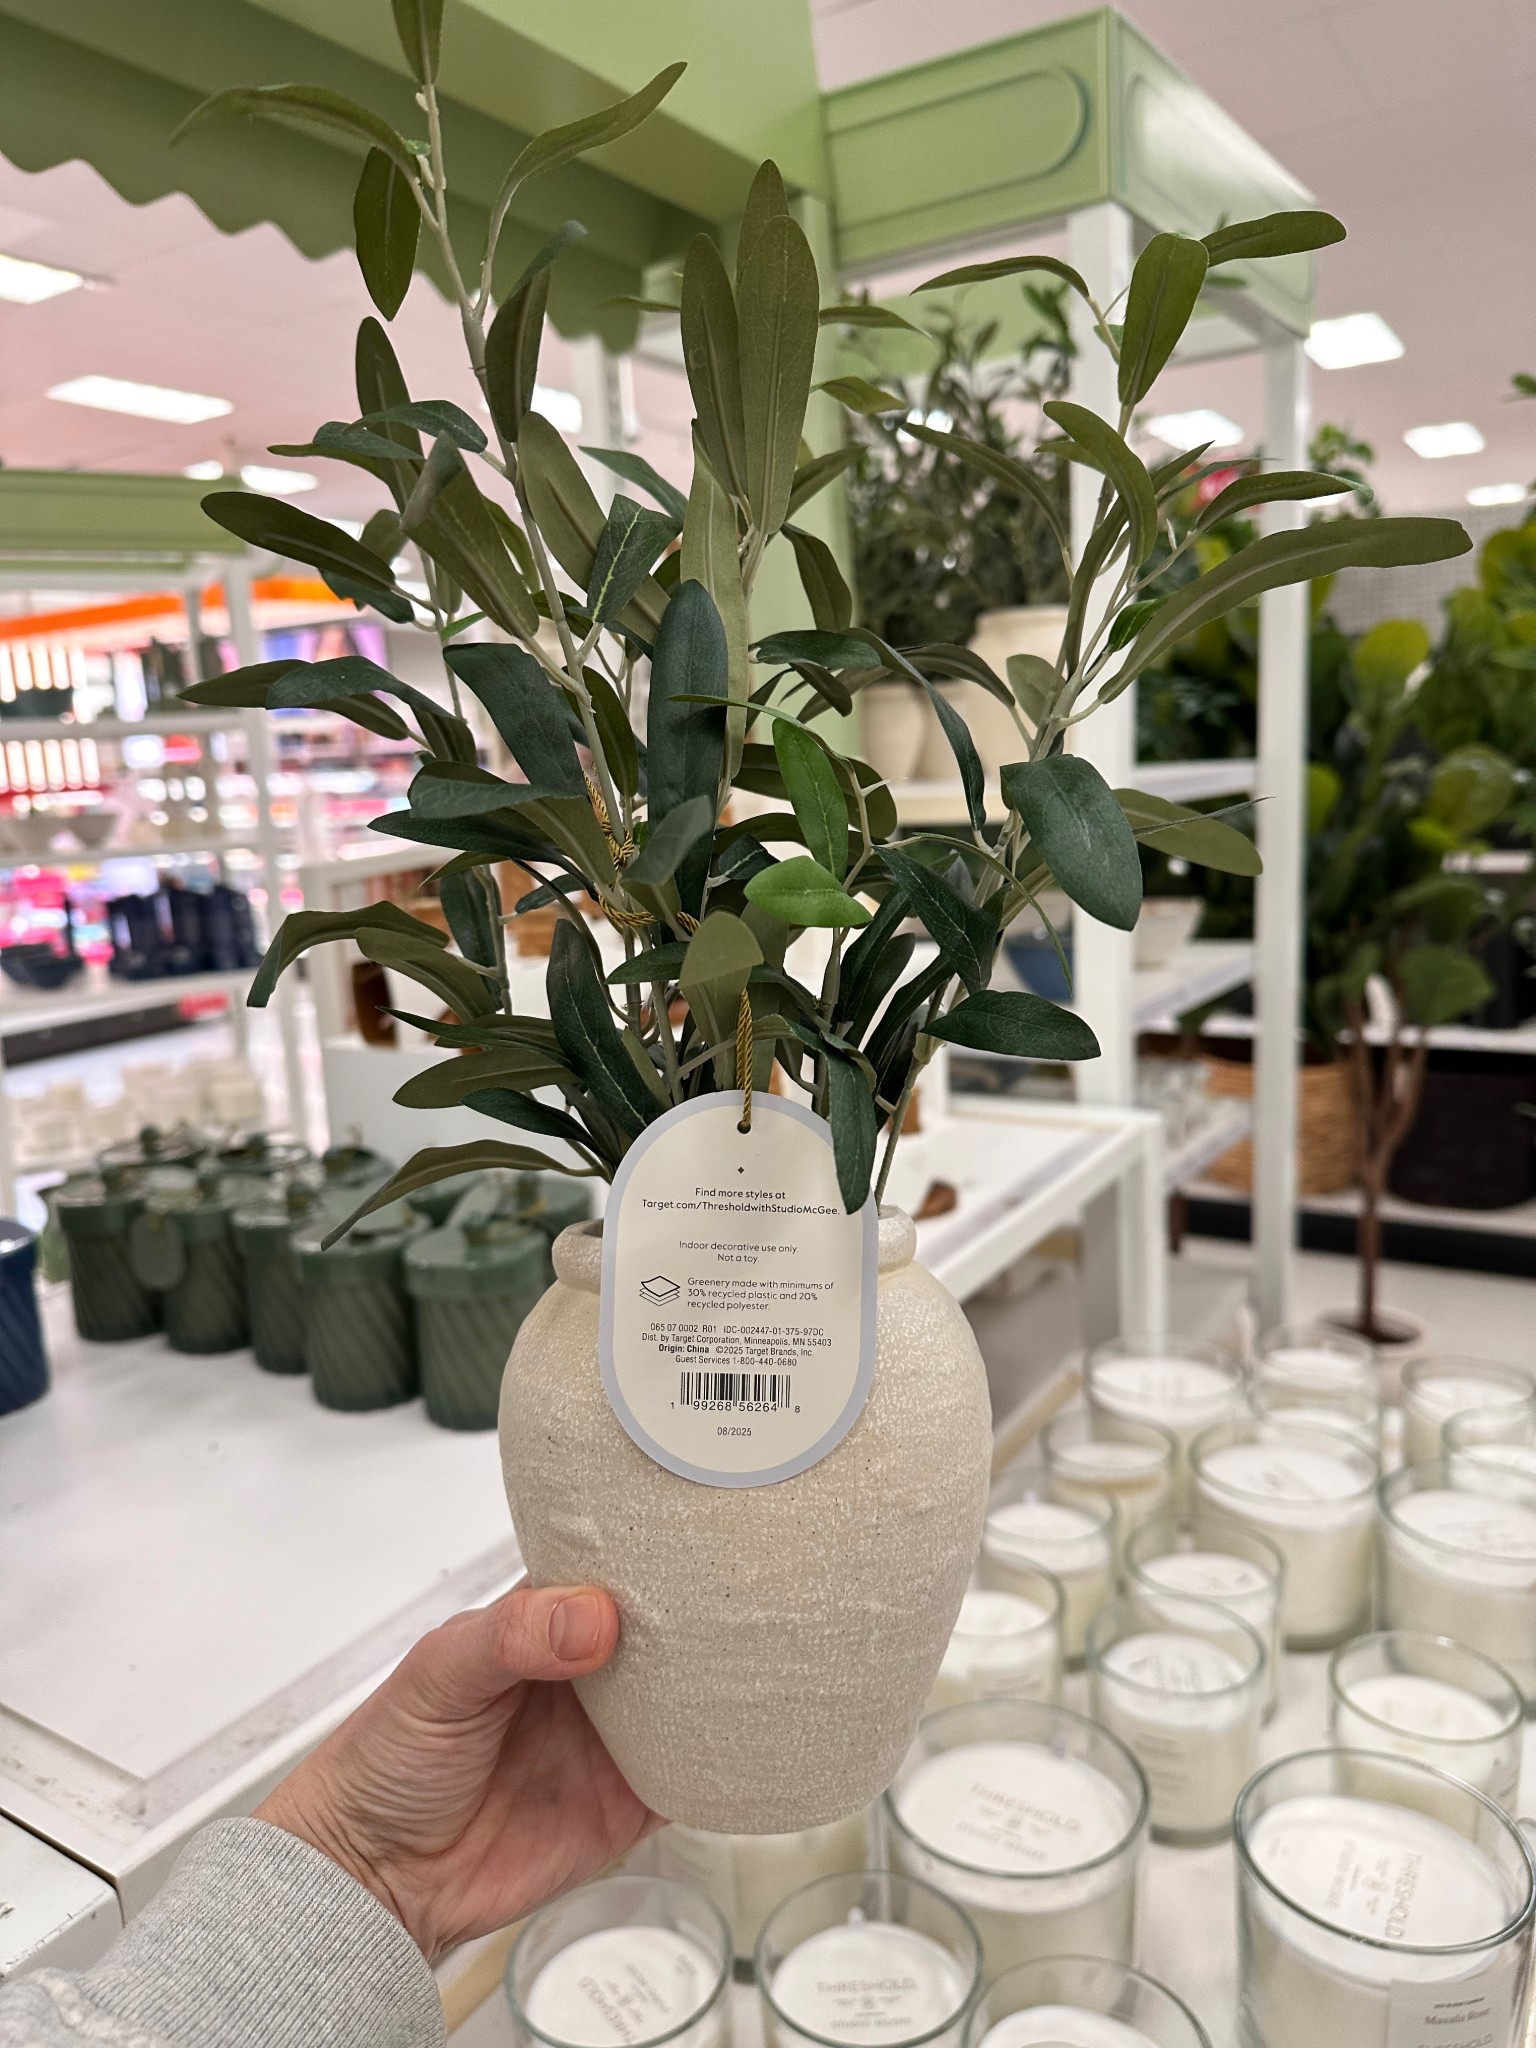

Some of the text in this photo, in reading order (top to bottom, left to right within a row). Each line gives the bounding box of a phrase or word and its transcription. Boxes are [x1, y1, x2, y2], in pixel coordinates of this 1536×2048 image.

[695, 1188, 786, 1200] Find more styles at
[679, 1241, 709, 1250] Indoor
[710, 1242, 760, 1251] decorative
[717, 1253, 734, 1262] Not
[687, 1277, 730, 1288] Greenery
[759, 1280, 779, 1288] with
[780, 1281, 823, 1289] minimums
[824, 1282, 834, 1290] of
[687, 1289, 818, 1300] 30% recycled plastic and 20%
[687, 1301, 725, 1310] recycled
[650, 1322, 666, 1332] 065
[667, 1323, 677, 1331] 07
[678, 1324, 699, 1333] 0002
[702, 1324, 717, 1333] R01
[660, 1333, 670, 1343] by
[671, 1333, 695, 1344] Target
[696, 1335, 742, 1345] Corporation,
[792, 1337, 806, 1346] MN
[807, 1338, 832, 1347] 55403
[658, 1343, 685, 1353] Origin:
[686, 1344, 710, 1353] China
[745, 1346, 769, 1357] Target
[770, 1347, 799, 1357] Brands,
[675, 1354, 697, 1363] Guest
[698, 1355, 731, 1365] Services
[693, 1400, 732, 1411] 99268
[738, 1402, 778, 1412] 56264
[794, 1405, 801, 1413] 8
[717, 1427, 752, 1436] 08/2025
